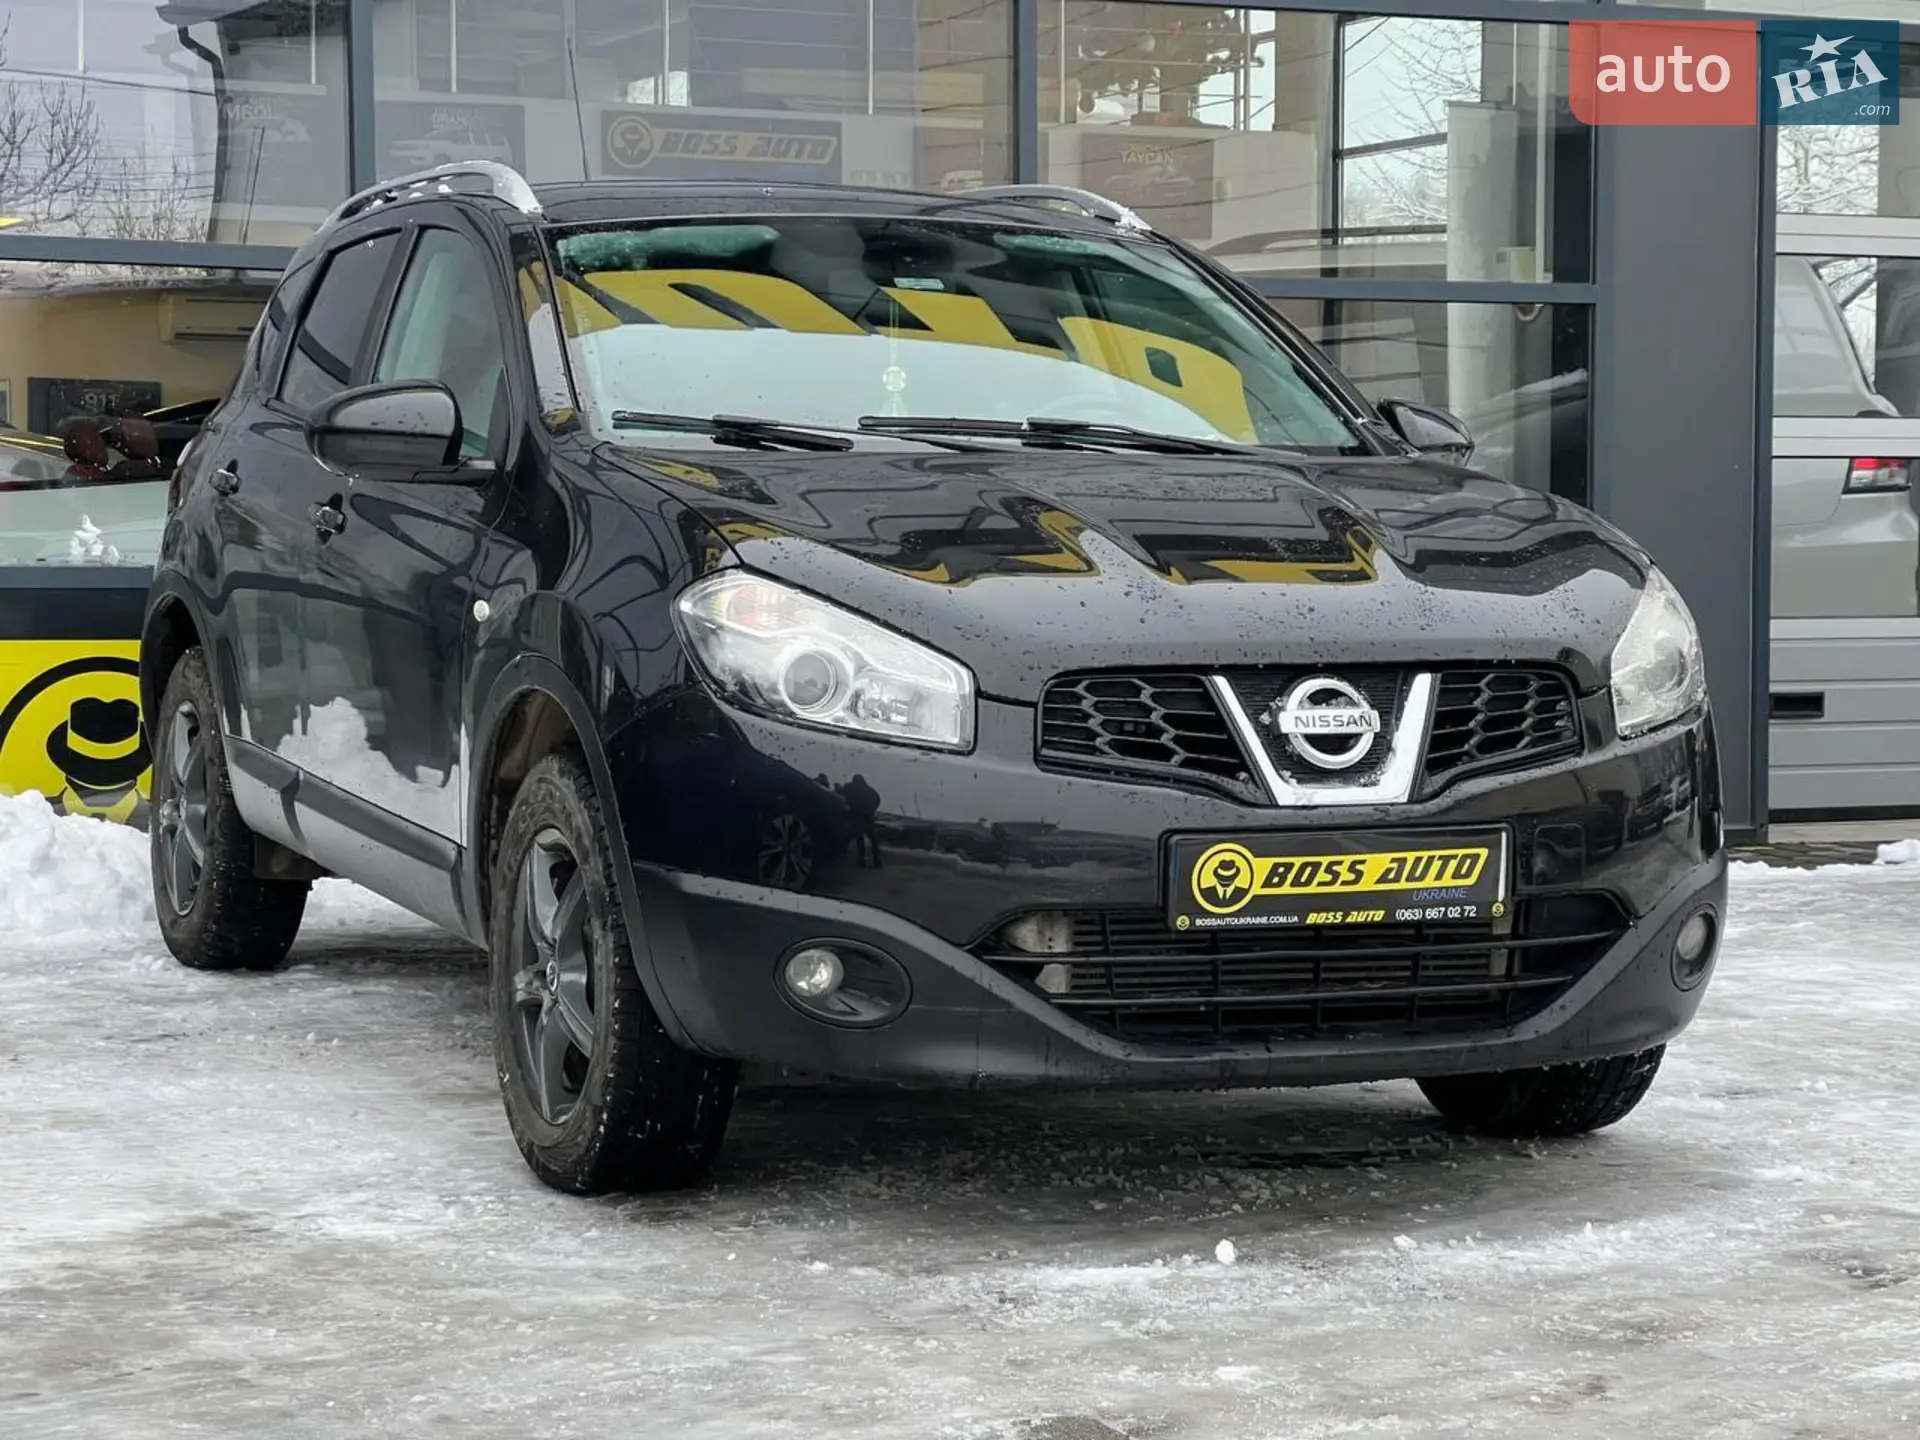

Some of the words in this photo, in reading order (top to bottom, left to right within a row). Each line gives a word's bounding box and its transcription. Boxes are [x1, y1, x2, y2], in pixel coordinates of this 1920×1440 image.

[658, 131, 739, 156] BOSS
[748, 135, 831, 161] AUTO
[1294, 714, 1372, 729] NISSAN
[1260, 859, 1367, 888] BOSS
[1374, 853, 1481, 885] AUTO
[1412, 887, 1469, 900] UKRAINE
[1195, 915, 1299, 926] BOSSAUTOUKRAINE.COM.UA
[1305, 911, 1342, 925] BOSS
[1345, 910, 1385, 923] AUTO
[1395, 908, 1422, 921] (063)
[1425, 907, 1445, 919] 667
[1447, 906, 1461, 918] 02
[1464, 905, 1477, 917] 72
